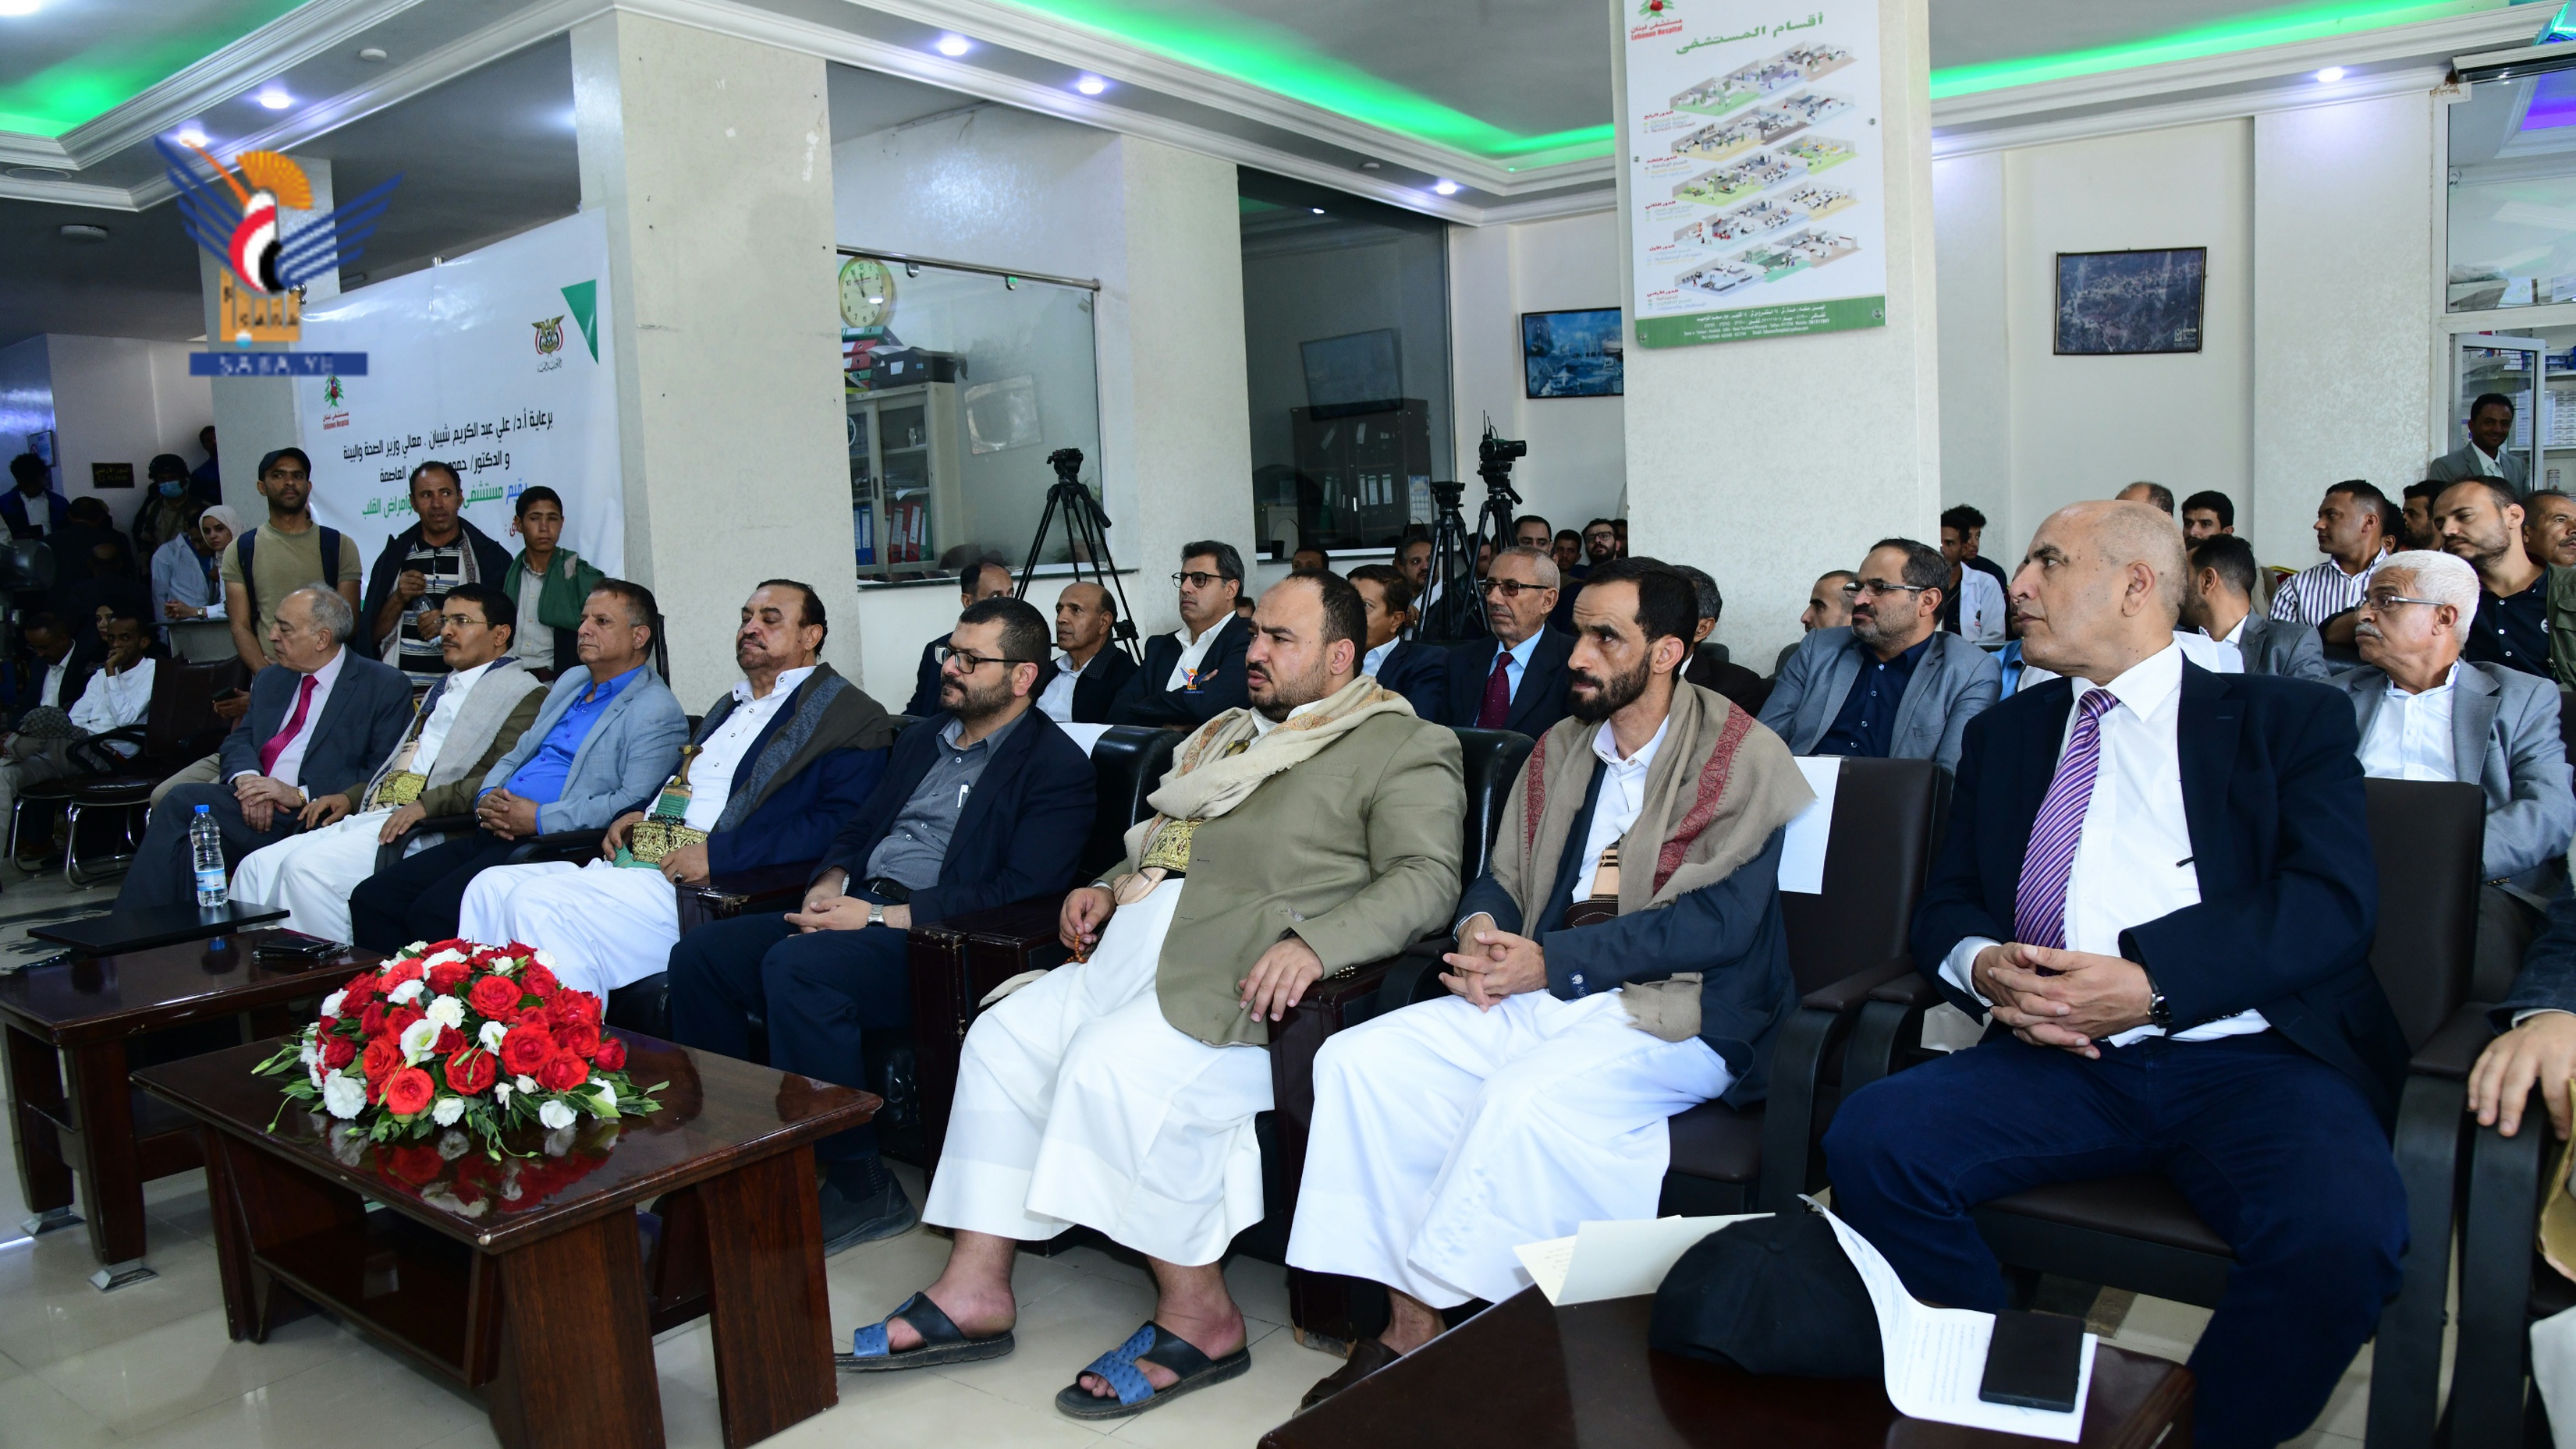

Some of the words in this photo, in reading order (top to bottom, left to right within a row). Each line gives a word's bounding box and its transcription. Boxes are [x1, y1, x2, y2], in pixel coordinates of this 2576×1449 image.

[1631, 24, 1648, 34] لبنان
[1631, 30, 1656, 41] Lebanon
[1658, 24, 1683, 36] Hospital
[1649, 19, 1683, 30] مستشفى
[1773, 12, 1824, 37] أقسام
[1676, 26, 1766, 55] المستشفى
[496, 416, 510, 443] علي
[530, 409, 553, 430] برعاية
[452, 422, 478, 446] الكريم
[481, 423, 493, 440] عبد
[343, 444, 363, 462] والبيئة
[364, 439, 383, 455] الصحة
[386, 436, 399, 457] وزير
[402, 434, 422, 459] معالي
[470, 450, 502, 475] الدكتور/
[505, 452, 510, 470] و
[380, 466, 406, 483] العاصمة
[463, 480, 503, 509] مستشفى
[362, 498, 381, 519] القلب
